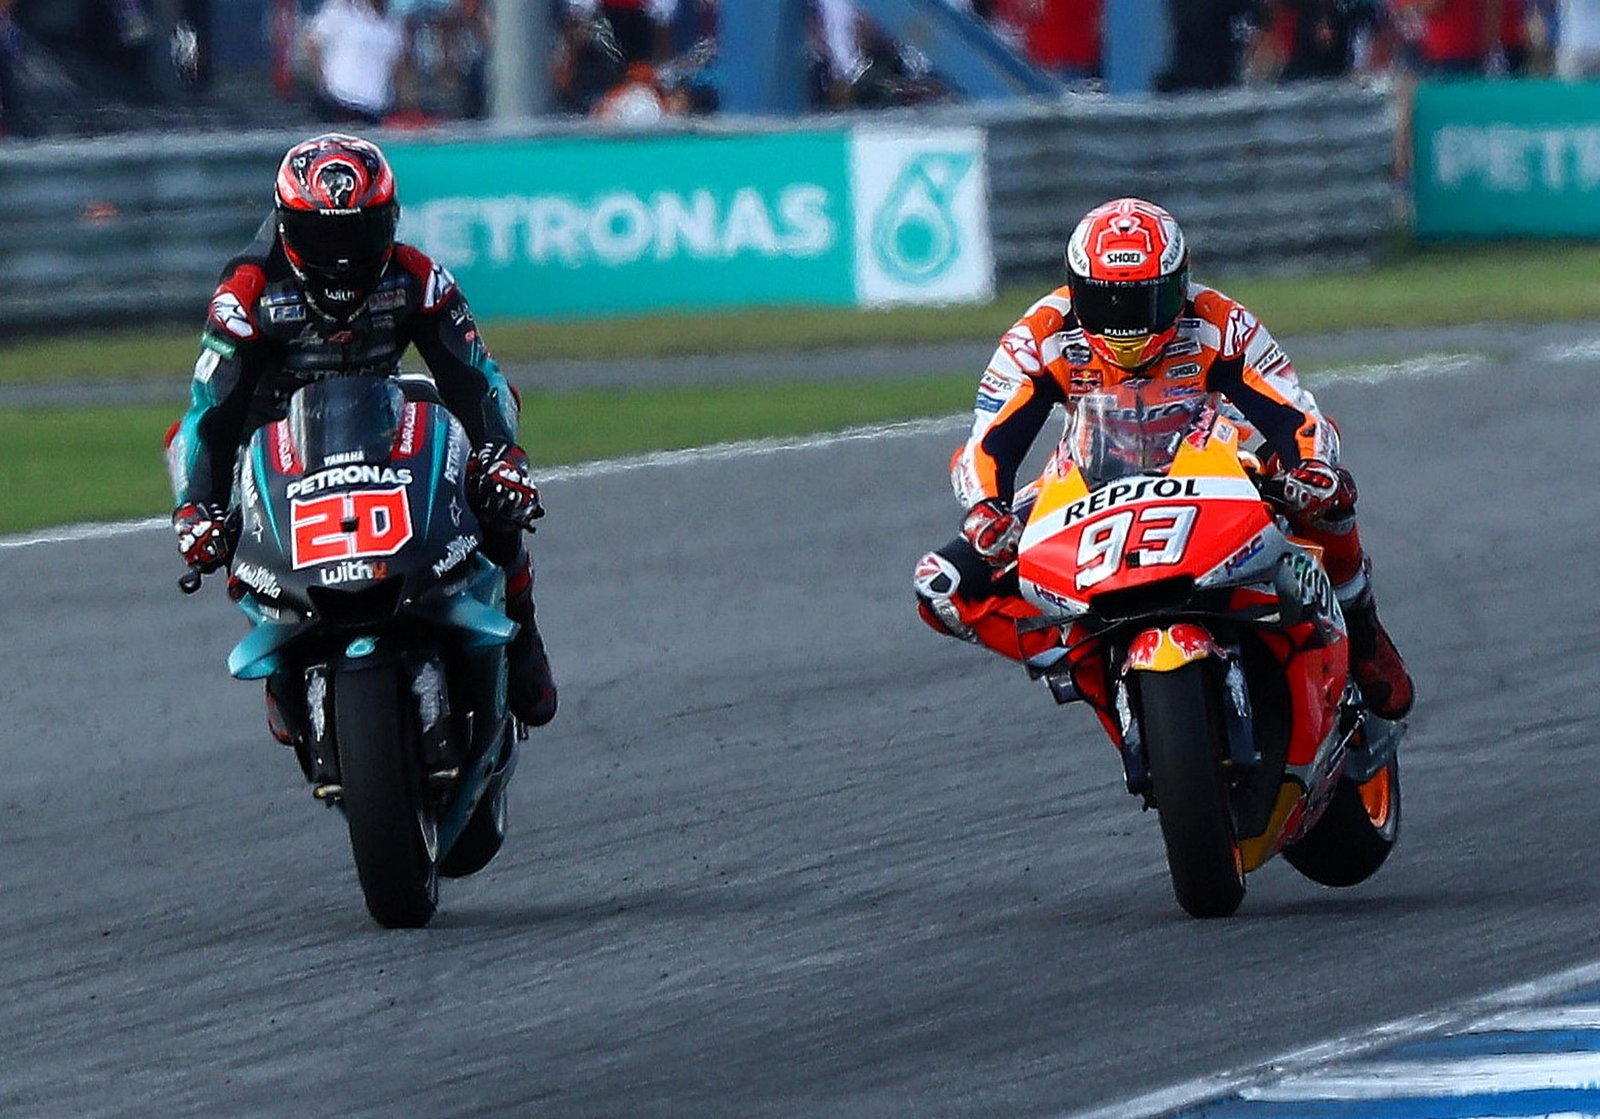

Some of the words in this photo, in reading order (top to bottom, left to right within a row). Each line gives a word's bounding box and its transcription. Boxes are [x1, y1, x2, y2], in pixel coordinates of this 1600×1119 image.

[1107, 252, 1140, 264] SHOEI
[324, 450, 364, 466] YAMAHA
[286, 465, 413, 499] PETRONAS
[1063, 479, 1201, 527] REPSOL
[291, 485, 413, 570] 20
[1074, 504, 1199, 593] 93
